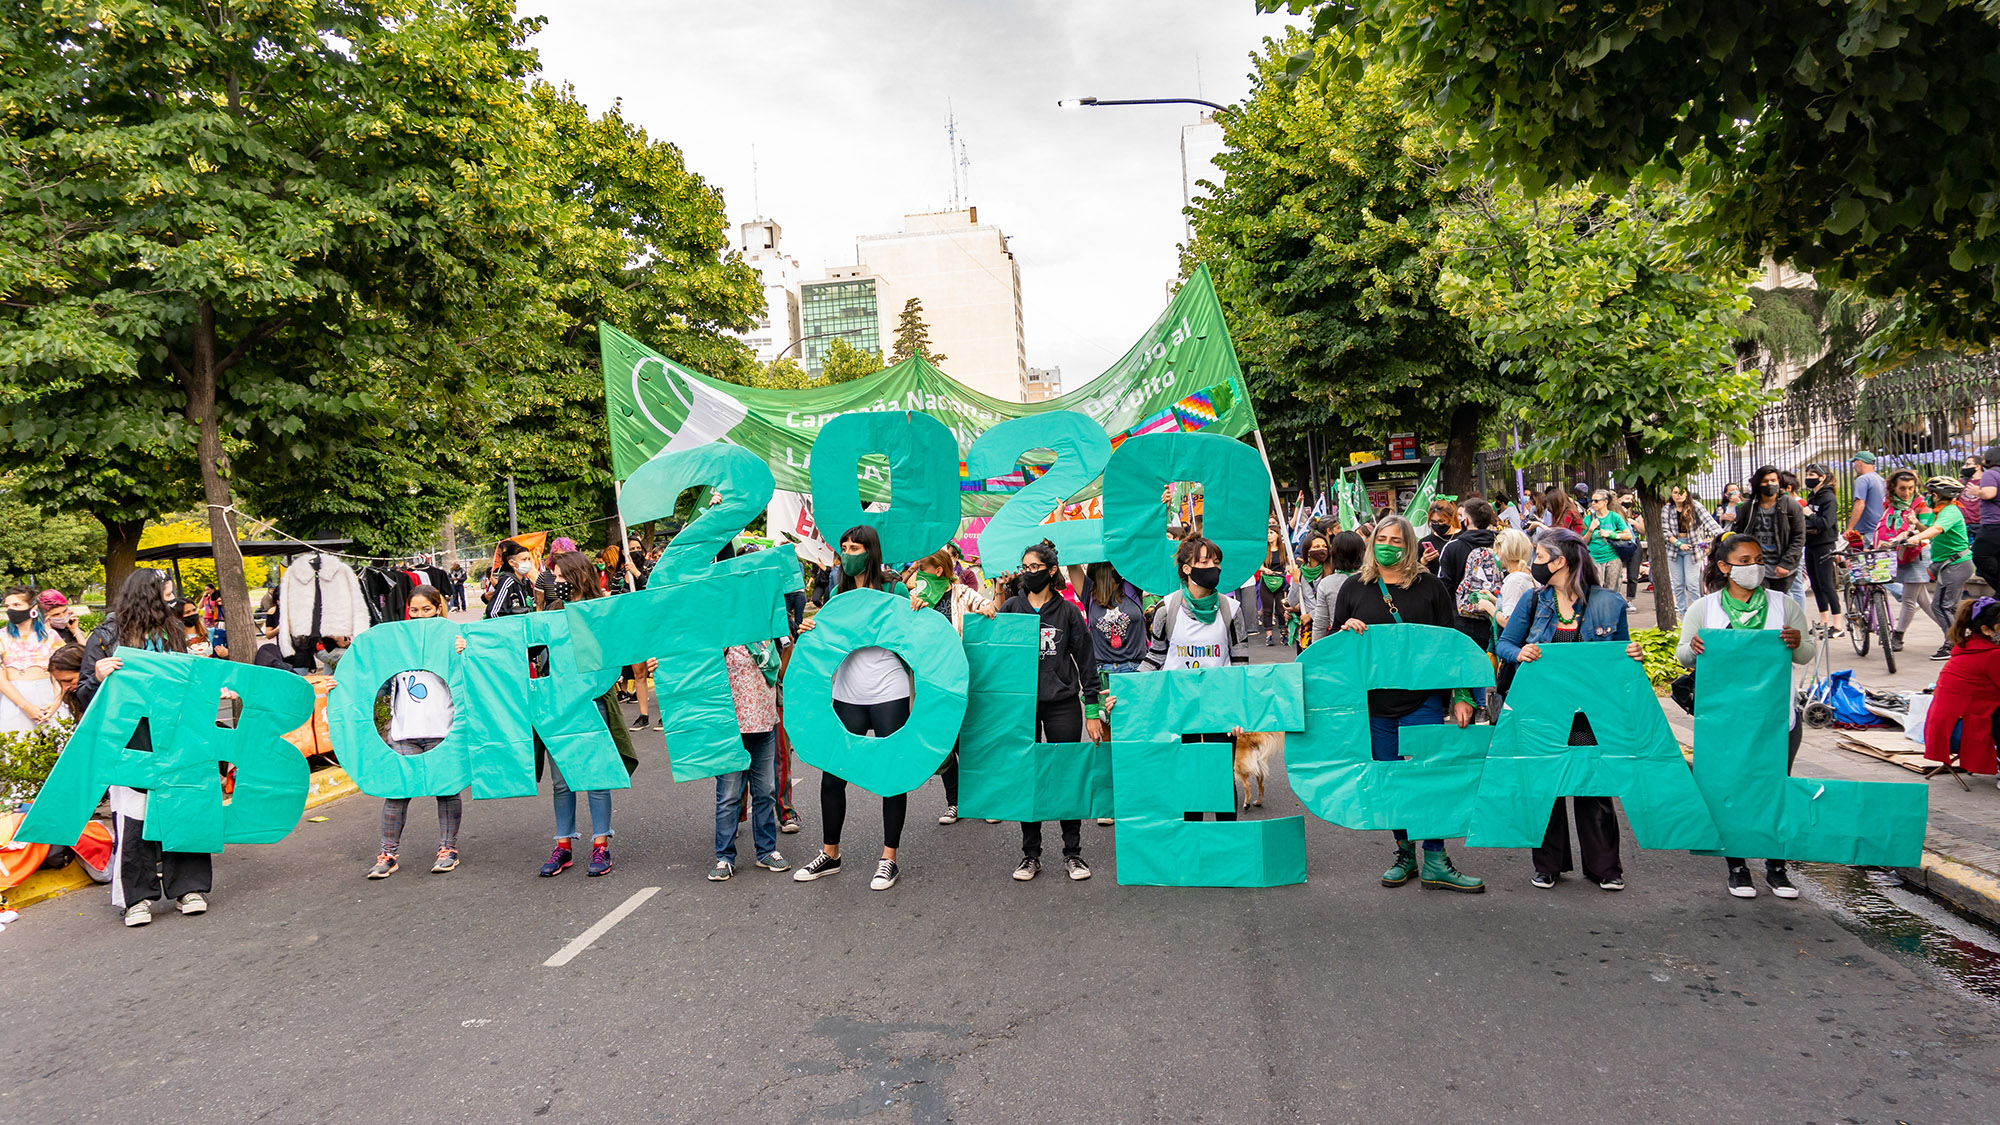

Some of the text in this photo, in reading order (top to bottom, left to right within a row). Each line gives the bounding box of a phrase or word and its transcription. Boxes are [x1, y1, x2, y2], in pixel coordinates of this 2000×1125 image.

[1171, 316, 1192, 347] al
[620, 409, 1272, 596] 2020
[14, 566, 1929, 887] ABORTO LEGAL
